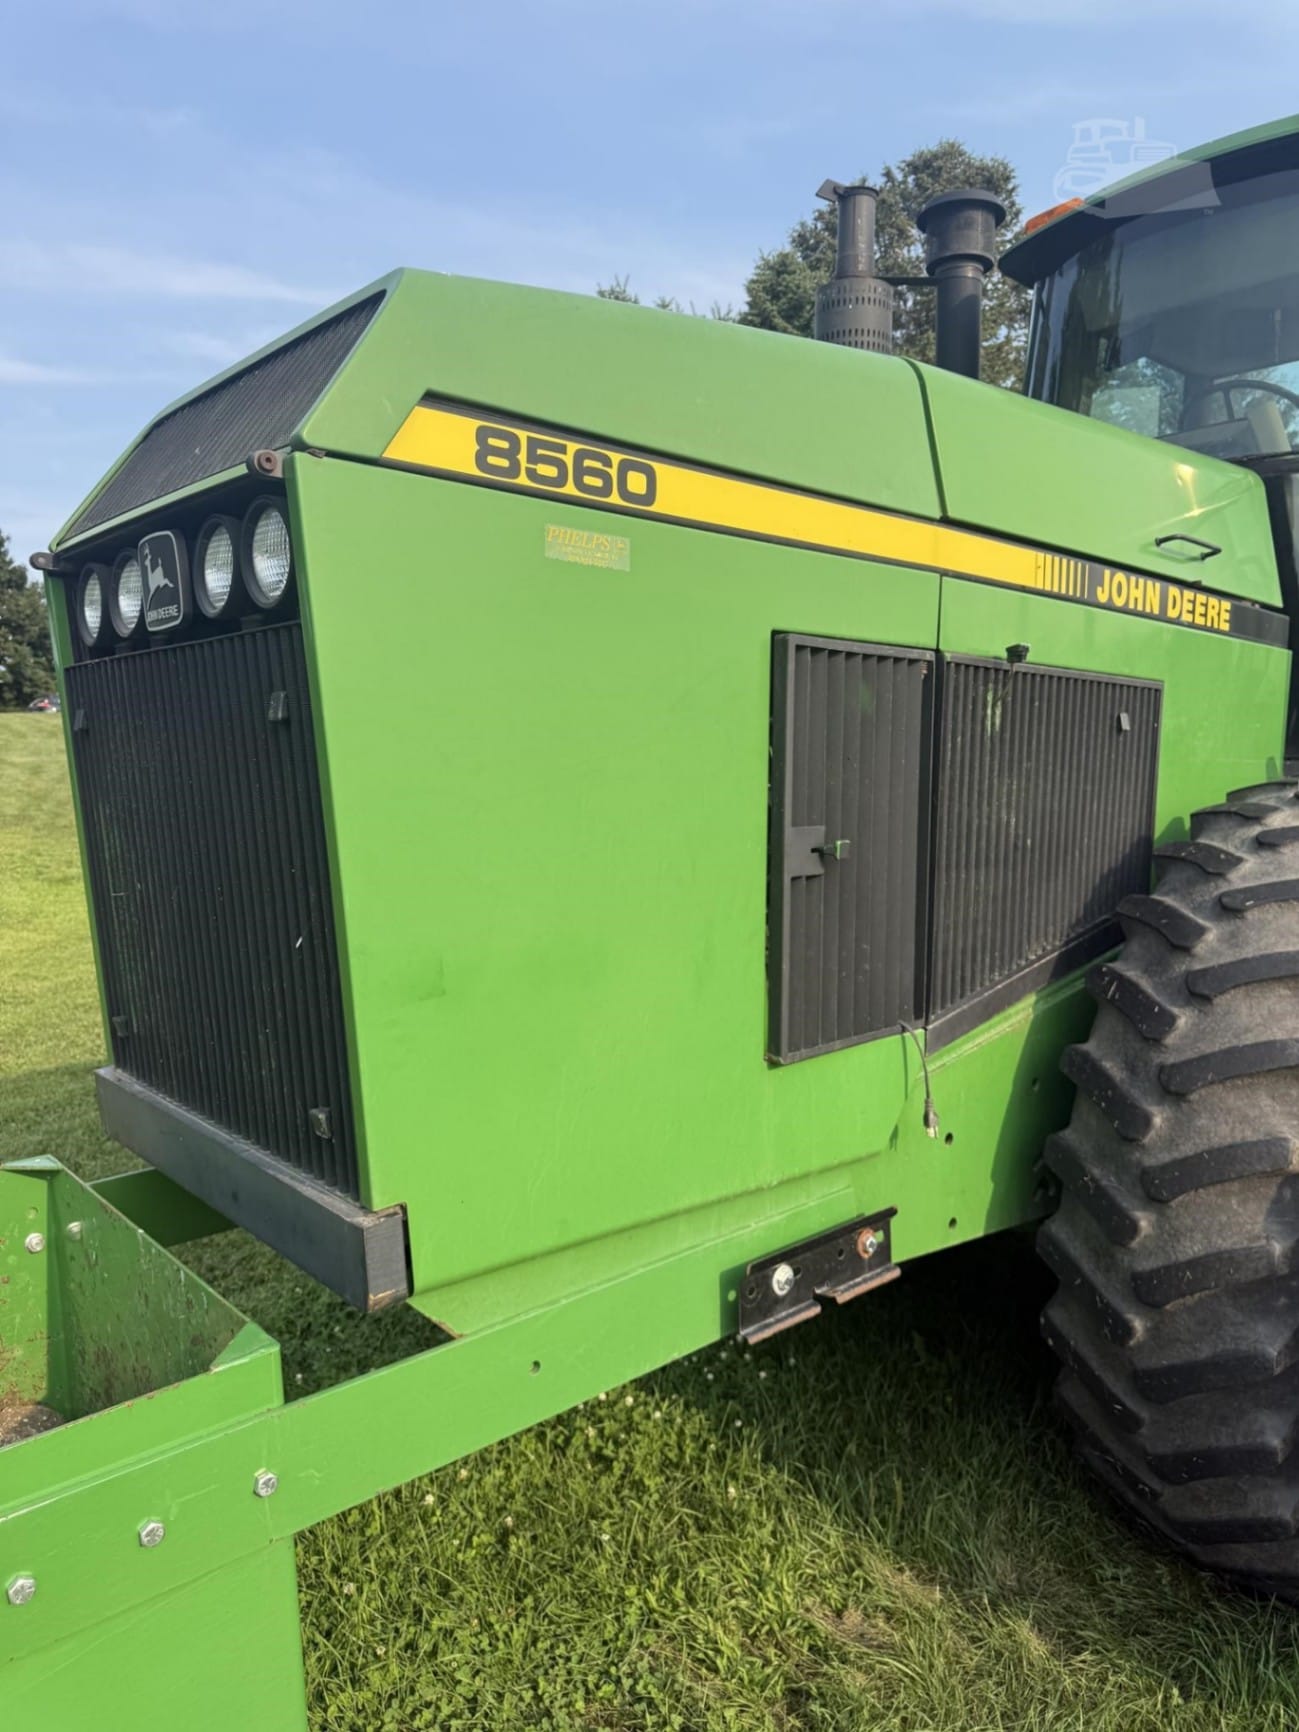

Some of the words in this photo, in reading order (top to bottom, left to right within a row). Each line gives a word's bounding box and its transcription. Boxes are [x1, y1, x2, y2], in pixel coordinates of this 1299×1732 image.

[475, 425, 657, 507] 8560
[547, 526, 610, 551] PHELPS
[158, 604, 179, 619] DEERE
[1096, 569, 1160, 615] JOHN
[1167, 587, 1232, 632] DEERE
